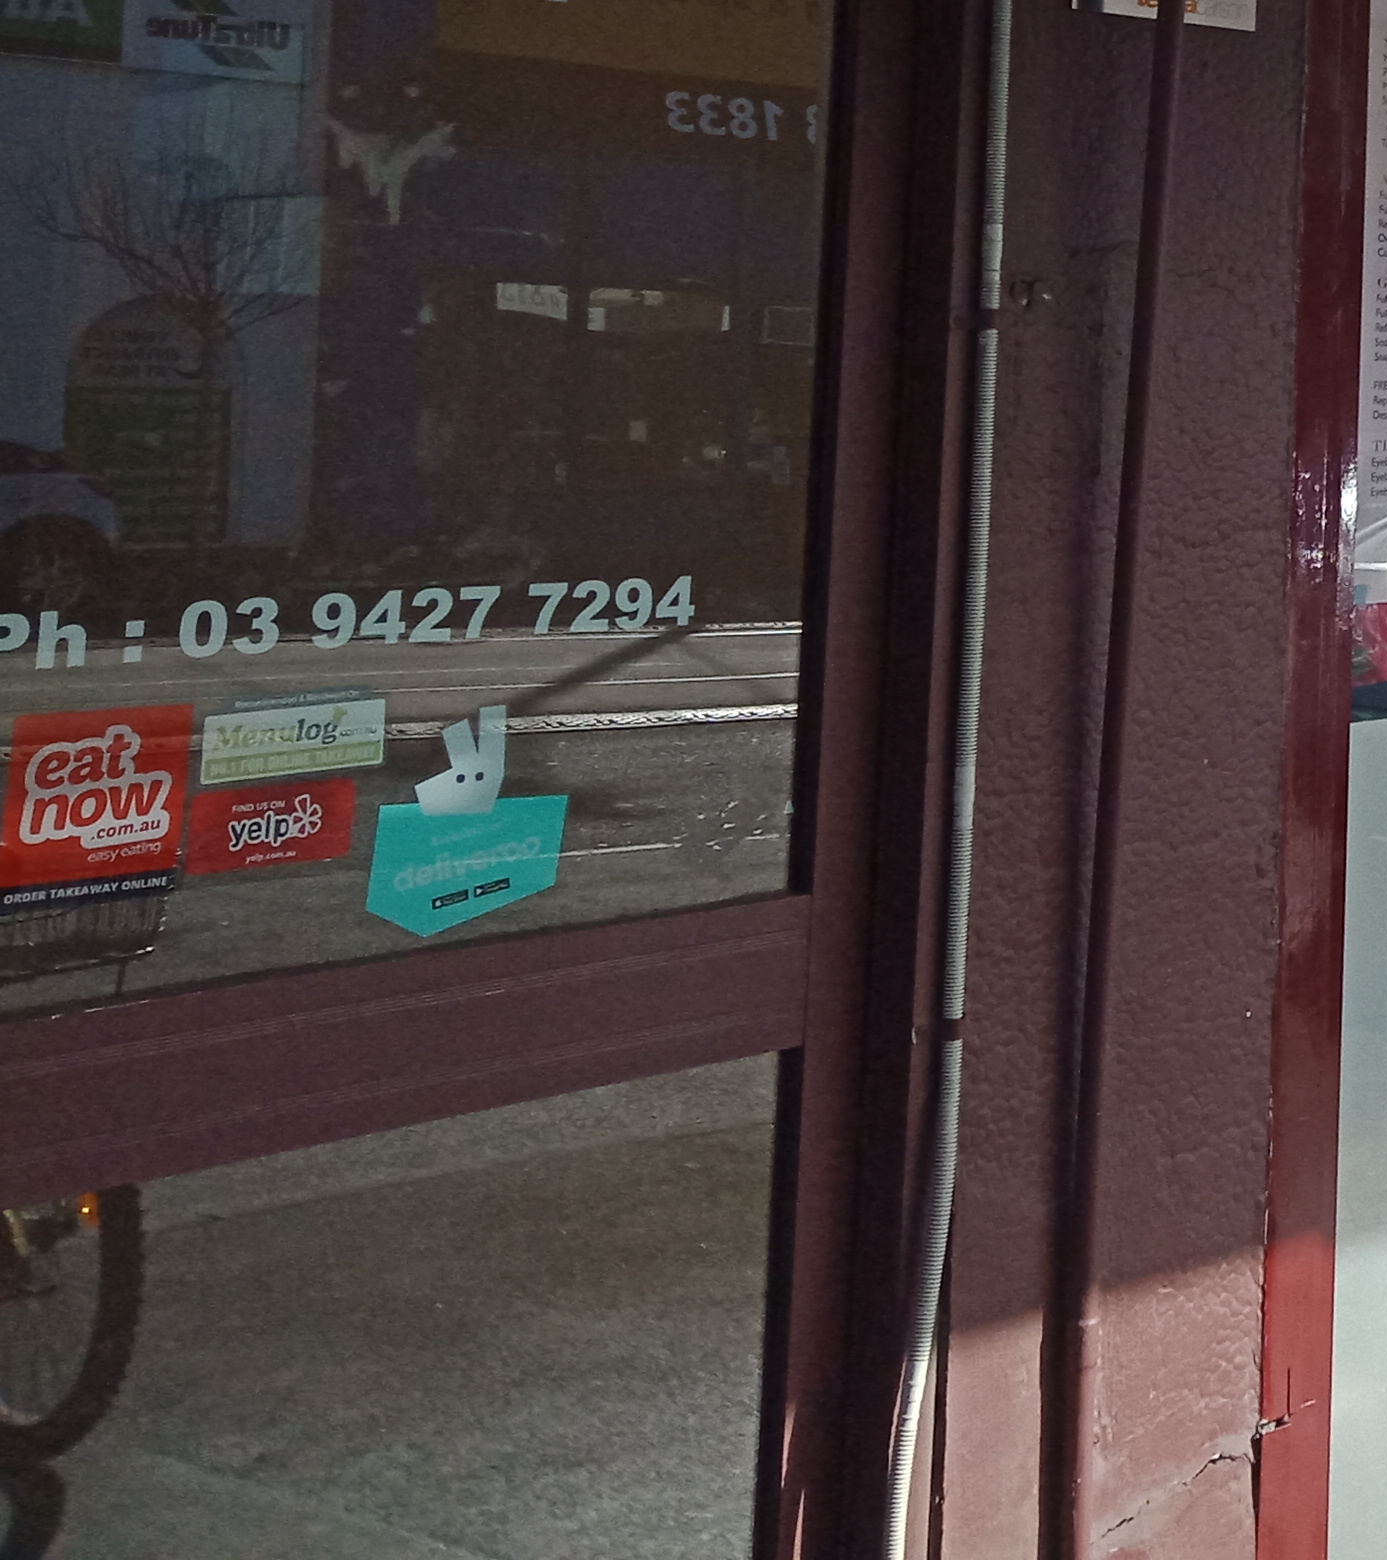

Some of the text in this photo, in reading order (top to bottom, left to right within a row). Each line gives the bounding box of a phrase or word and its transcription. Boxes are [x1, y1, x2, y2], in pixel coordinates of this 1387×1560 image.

[179, 597, 279, 658] 03
[310, 585, 503, 650] 9427
[527, 575, 696, 635] 7294
[213, 718, 338, 751] Menulog
[34, 733, 132, 790] eat
[30, 779, 164, 836] now
[232, 800, 285, 814] FIND US ON
[229, 811, 291, 851] yelp
[87, 840, 162, 863] easy eating
[246, 849, 296, 865] yelp.com.au
[4, 876, 168, 904] ORDER TAKEAWAY ONLINE
